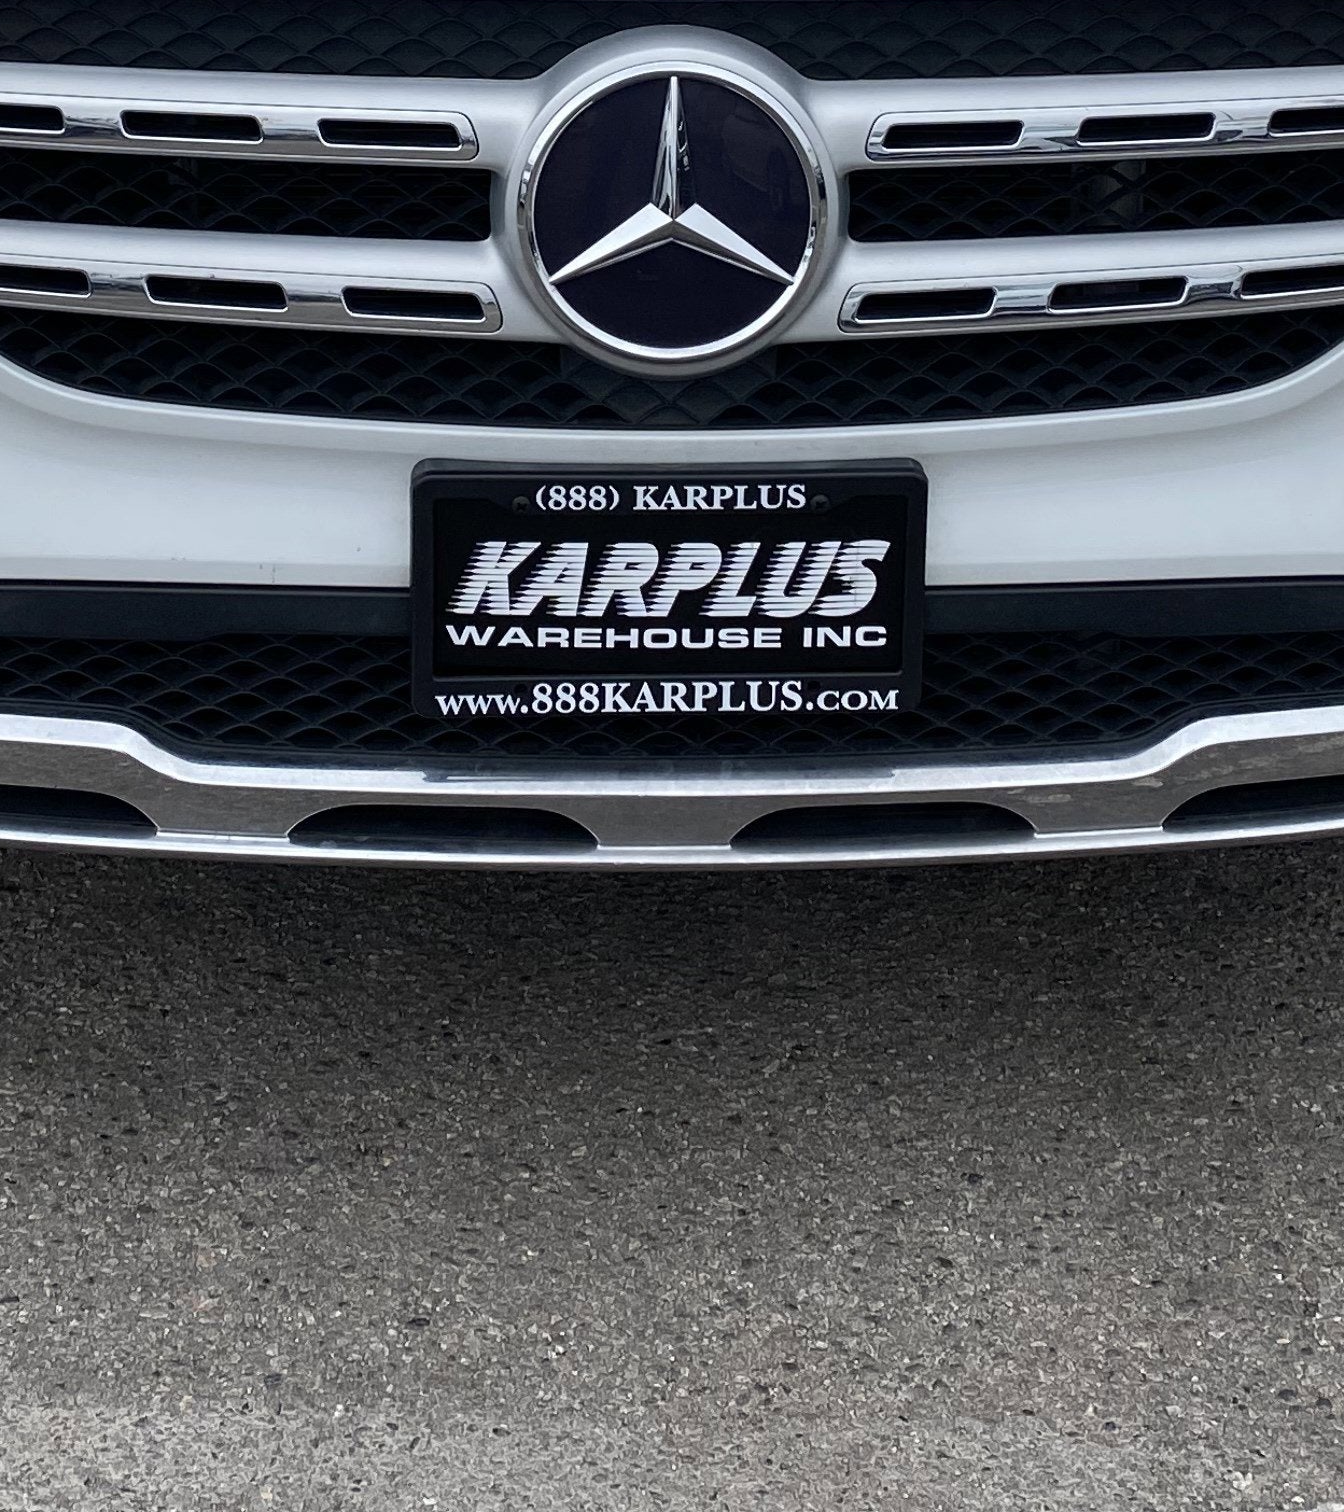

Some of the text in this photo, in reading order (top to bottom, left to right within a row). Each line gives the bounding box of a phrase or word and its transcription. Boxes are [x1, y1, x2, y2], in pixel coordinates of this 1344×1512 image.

[535, 483, 807, 512] (888) KARPLUS
[444, 538, 892, 618] KARPLUS
[445, 624, 888, 650] WAREHOUSE INC
